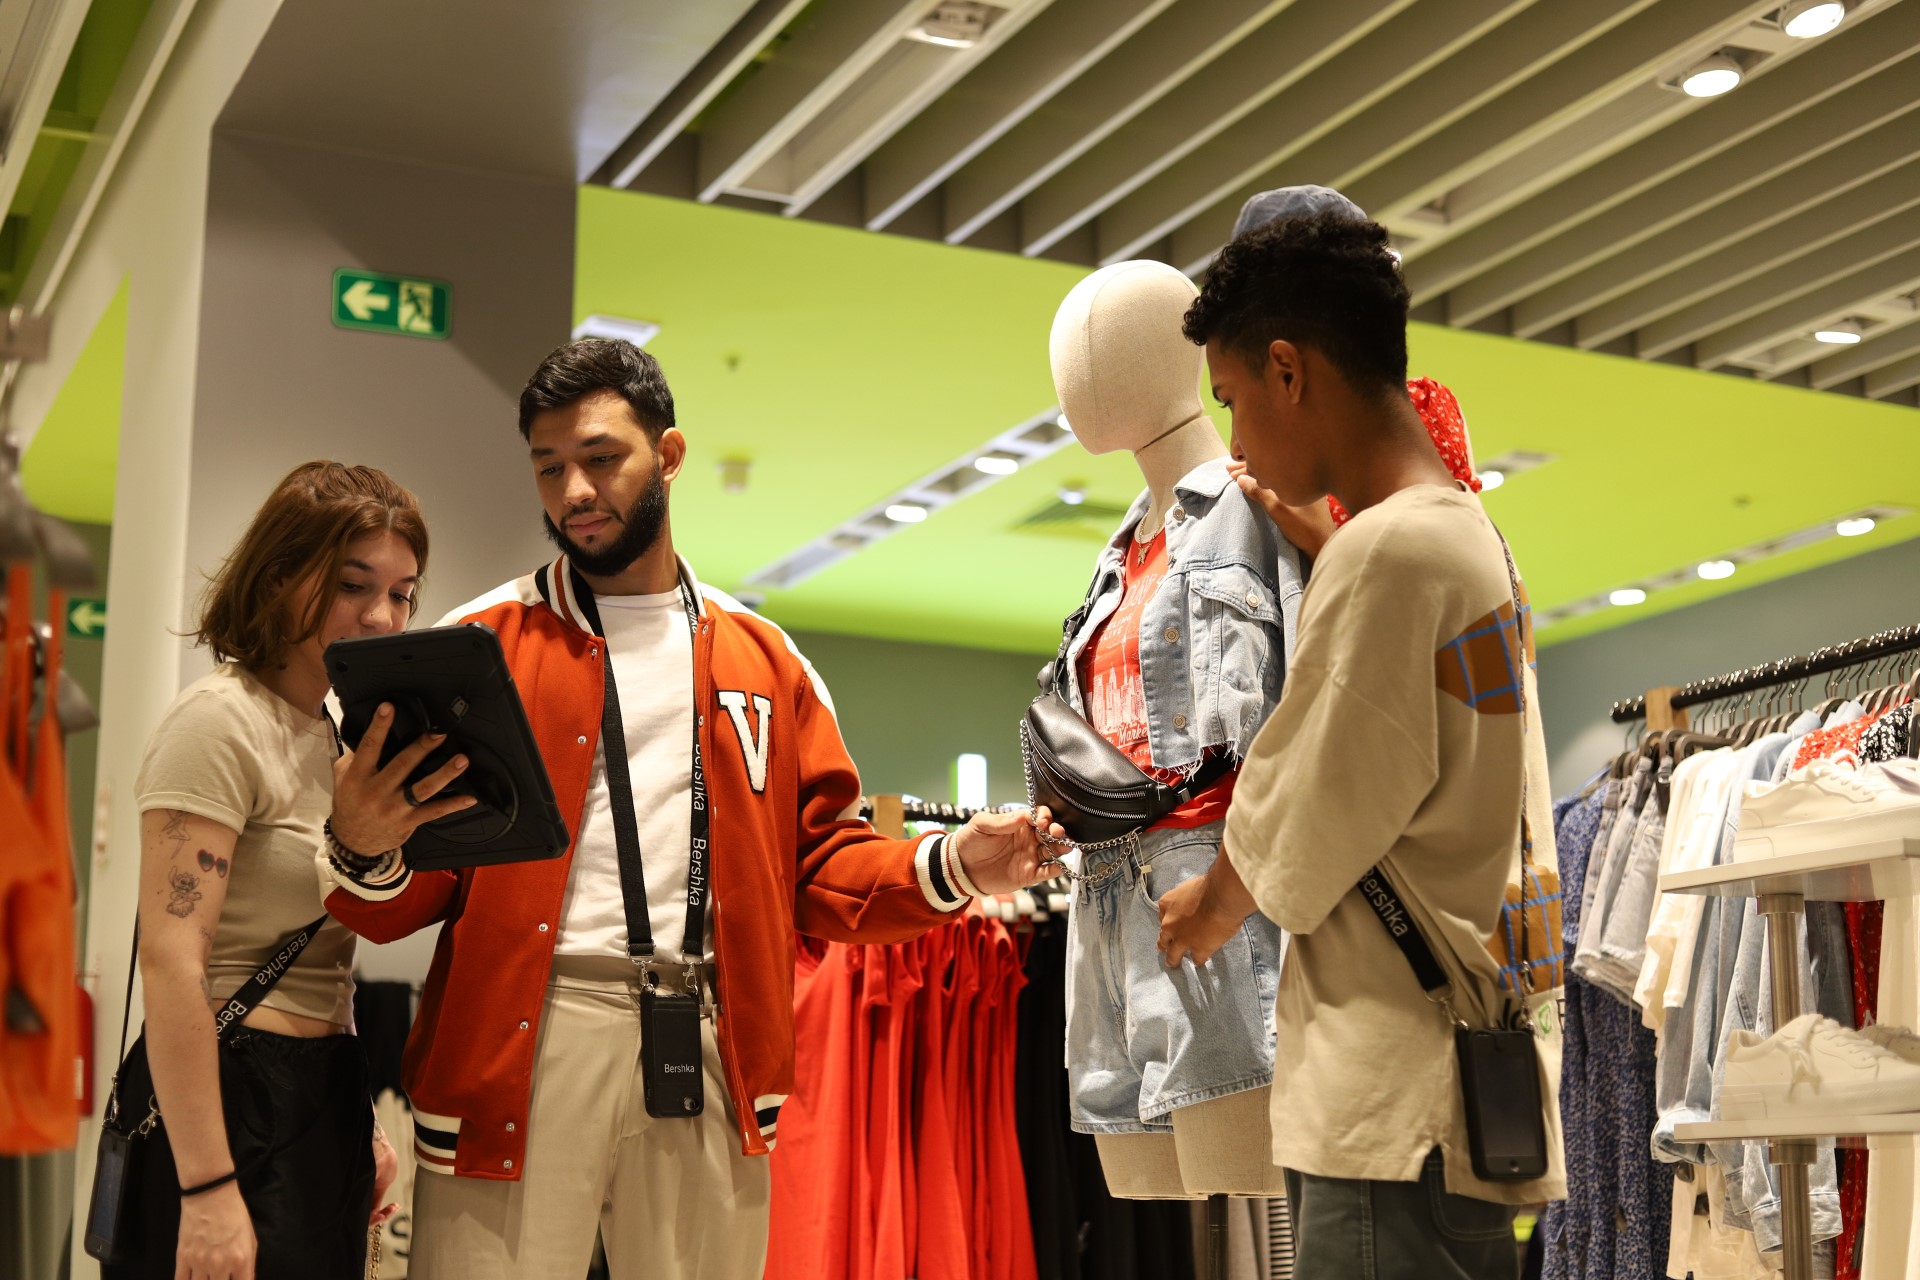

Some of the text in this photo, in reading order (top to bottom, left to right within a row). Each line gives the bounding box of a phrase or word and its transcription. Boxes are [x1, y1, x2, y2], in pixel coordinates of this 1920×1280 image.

[717, 691, 772, 793] V
[1117, 723, 1148, 746] Marke
[690, 837, 706, 906] Bershka
[216, 931, 308, 1039] Bershka Bers
[664, 1063, 695, 1073] Bershka
